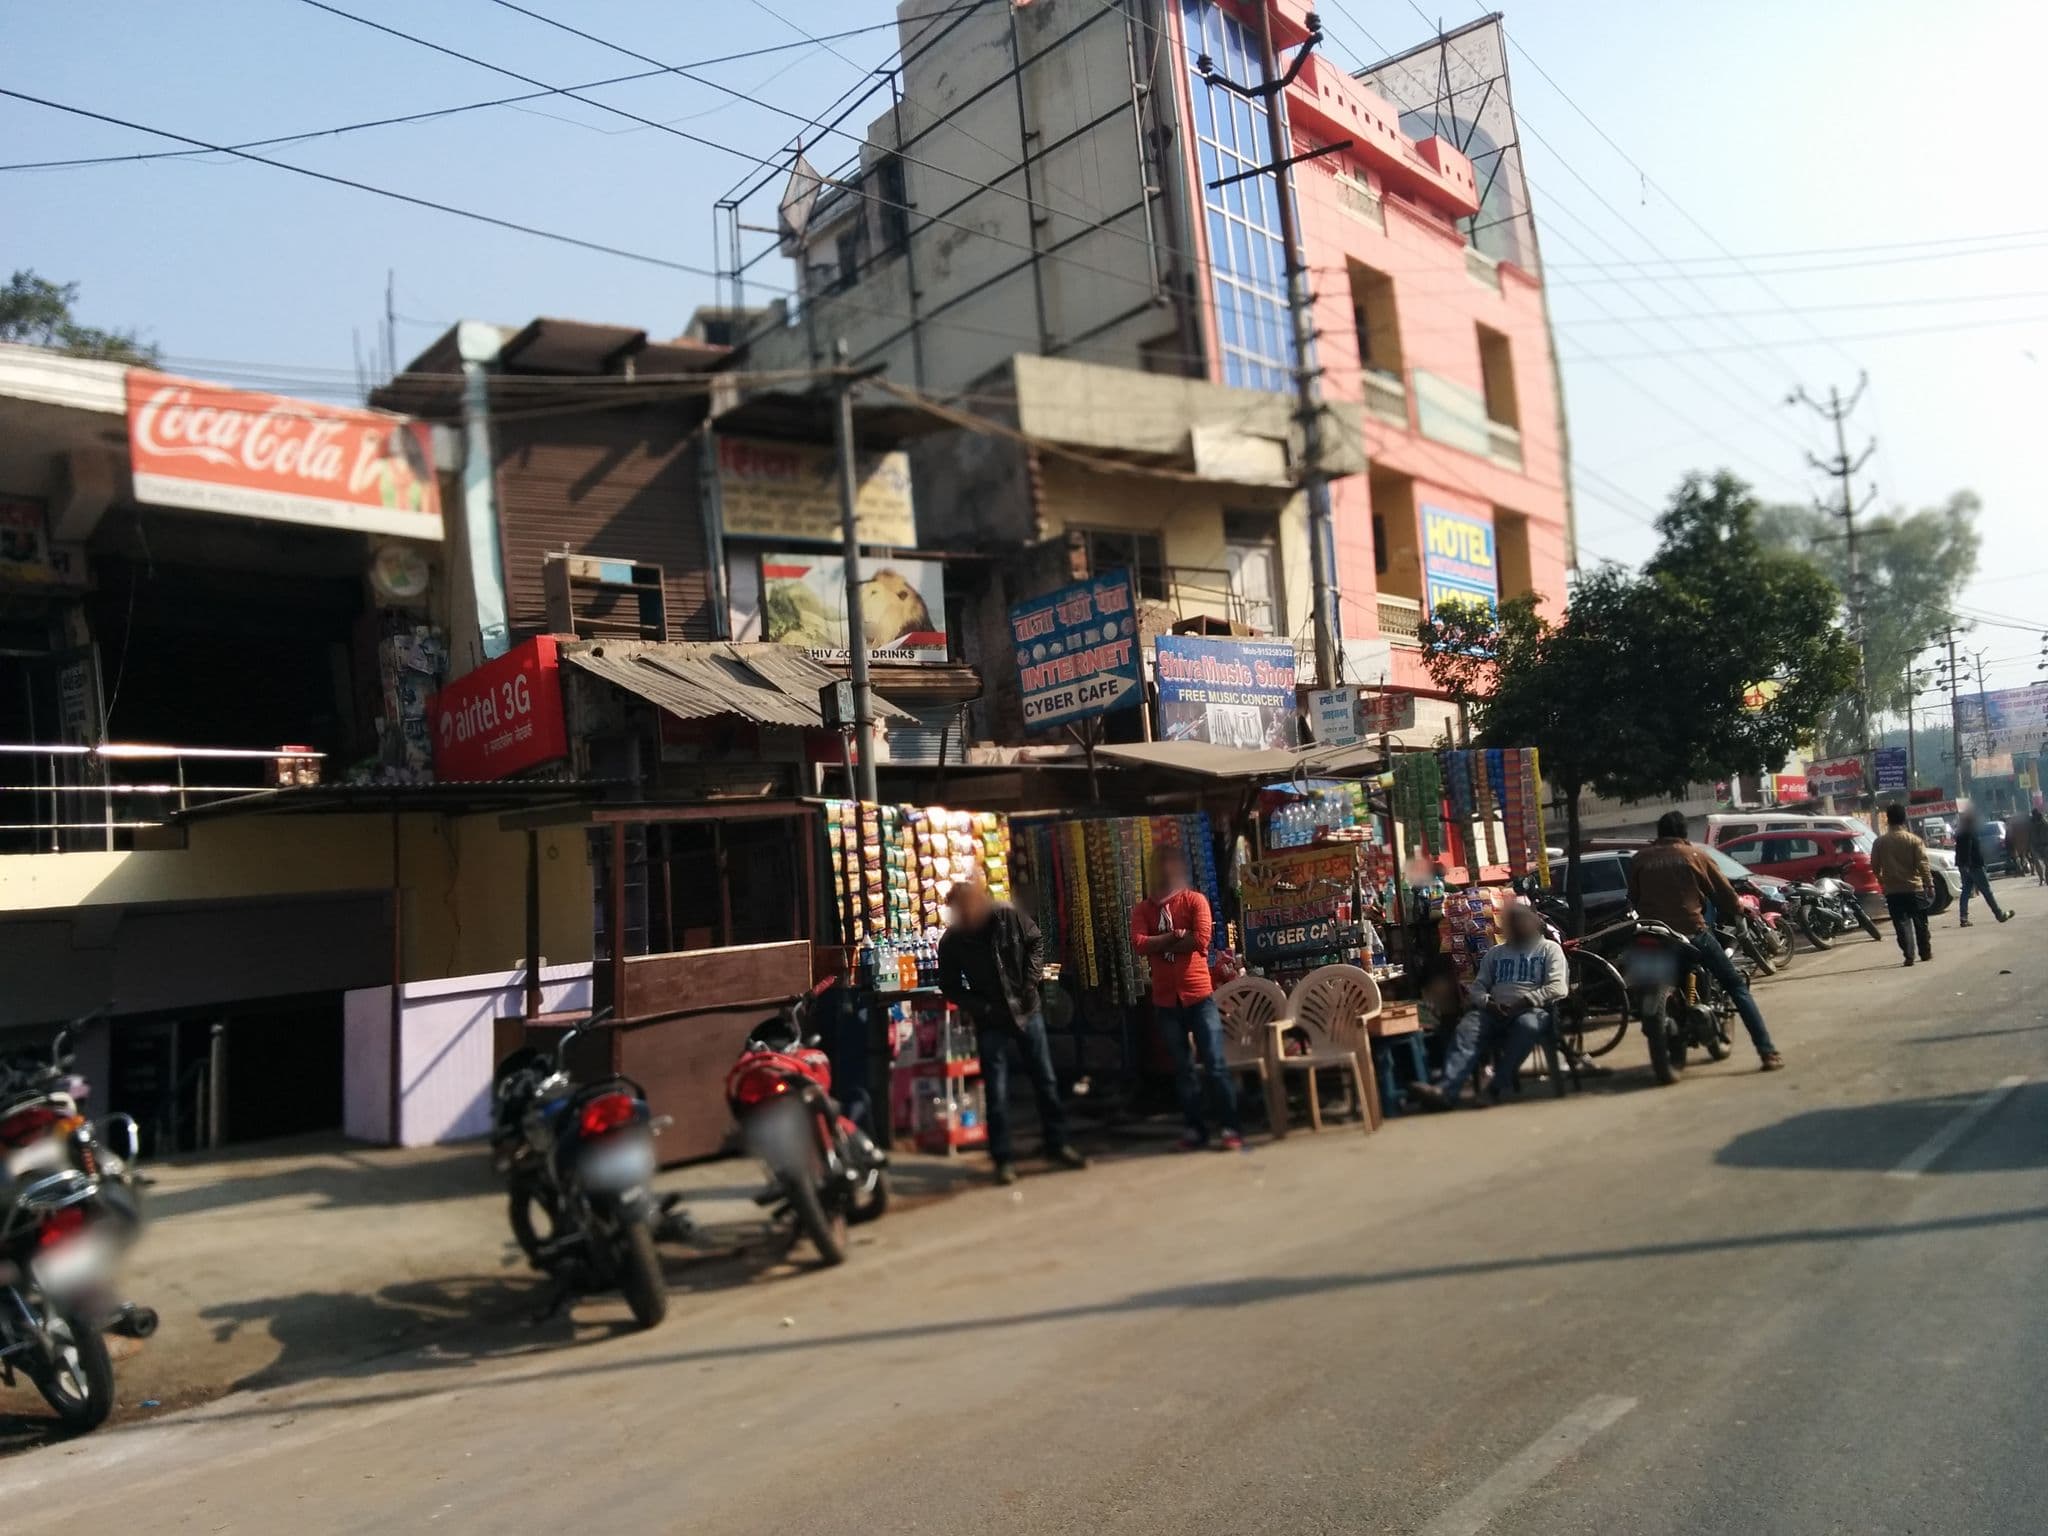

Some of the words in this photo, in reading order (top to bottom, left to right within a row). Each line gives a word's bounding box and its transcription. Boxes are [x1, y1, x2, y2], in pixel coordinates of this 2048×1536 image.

[135, 387, 346, 479] Coca-Cola
[1426, 513, 1492, 567] HOTEL
[804, 649, 832, 659] SHIV
[872, 650, 915, 659] DRINKS
[1021, 639, 1132, 692] INTERNET
[1254, 660, 1296, 695] Shop
[456, 687, 501, 742] airtel
[502, 674, 531, 720] 3G
[1025, 692, 1074, 717] CYBER
[1078, 680, 1119, 704] CAFE
[1179, 689, 1207, 702] FREE
[1208, 691, 1239, 704] MUSIC
[1240, 694, 1285, 707] CONCERT
[1257, 927, 1306, 948] CYBER
